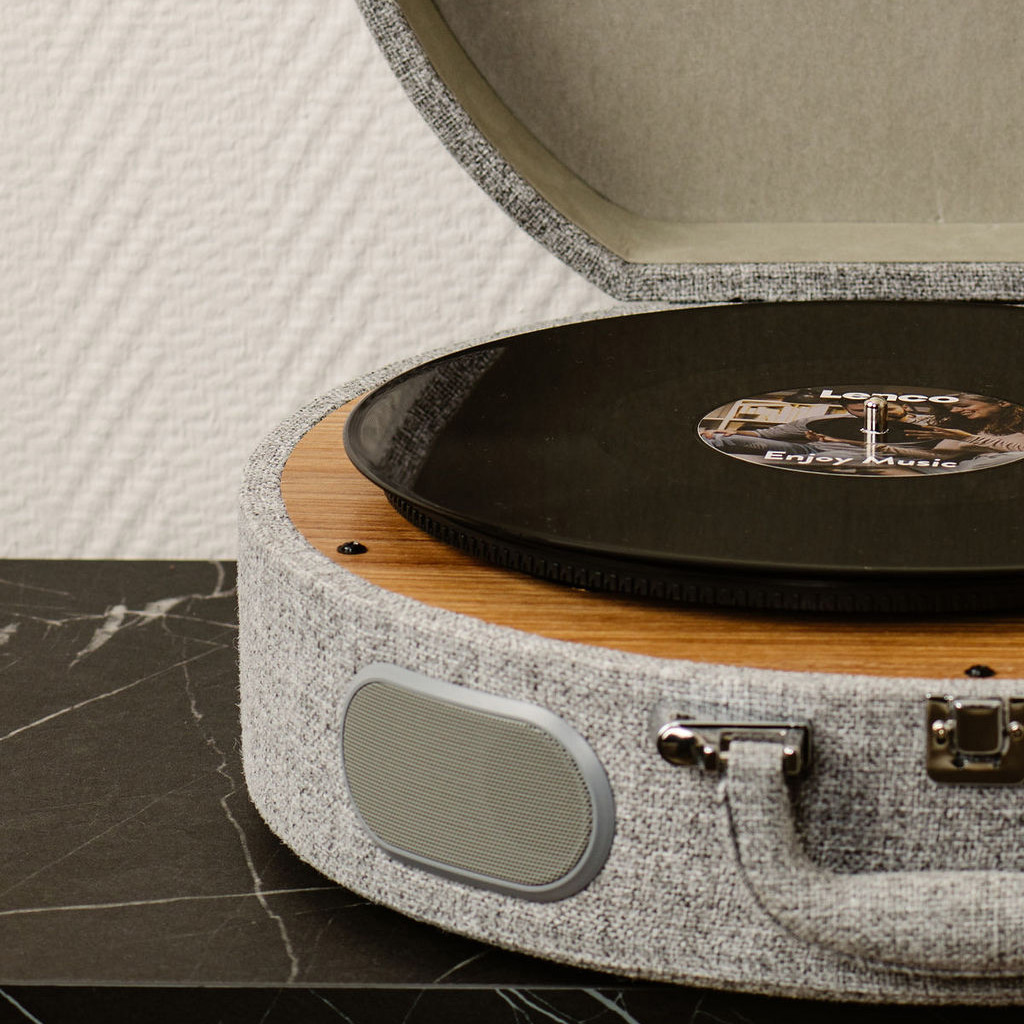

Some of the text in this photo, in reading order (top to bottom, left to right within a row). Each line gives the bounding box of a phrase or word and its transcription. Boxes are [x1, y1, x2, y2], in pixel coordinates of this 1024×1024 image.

[819, 389, 960, 403] Lenco
[763, 450, 958, 468] Enjoy Music
